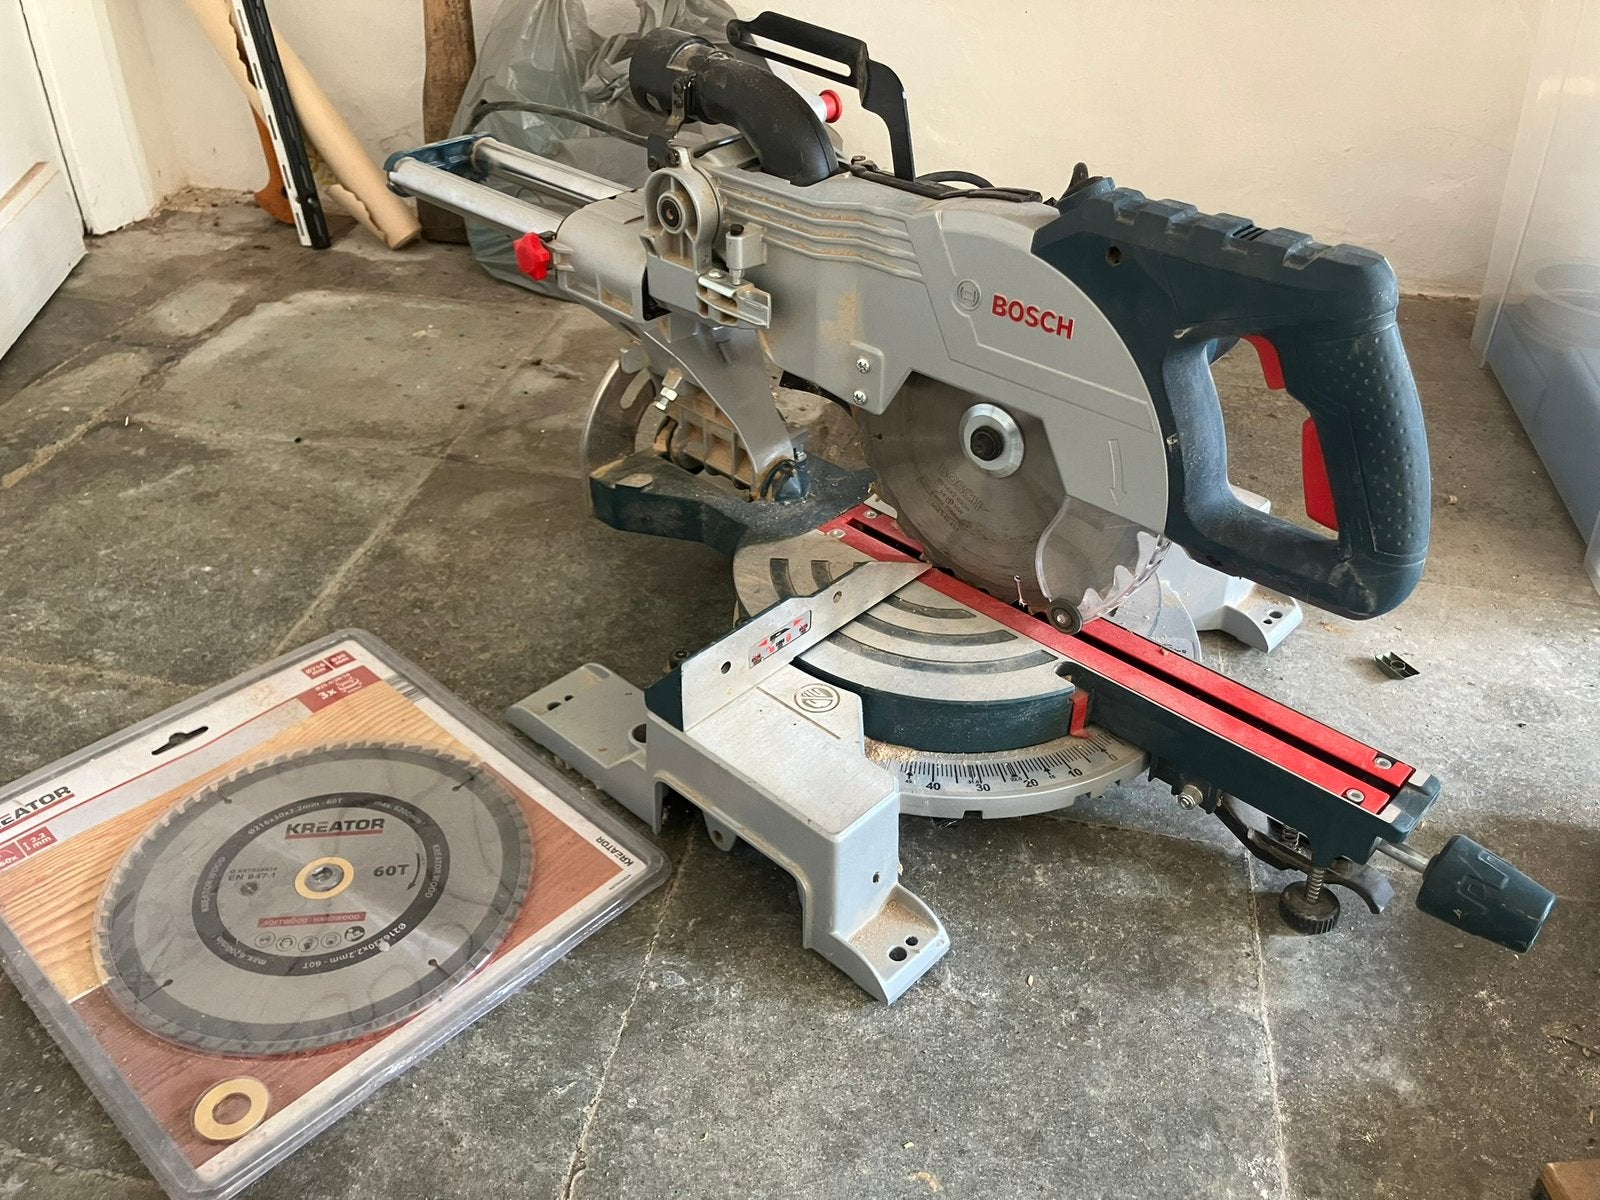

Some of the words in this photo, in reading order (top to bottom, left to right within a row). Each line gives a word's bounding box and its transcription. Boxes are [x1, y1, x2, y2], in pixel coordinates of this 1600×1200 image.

[992, 294, 1075, 340] BOSCH
[318, 689, 337, 700] 3x
[1068, 768, 1083, 778] 10
[925, 782, 941, 791] 40
[976, 783, 991, 792] 30
[1024, 779, 1039, 788] 20
[0, 786, 71, 828] EATOR
[326, 797, 343, 805] 60T
[285, 818, 385, 835] KREATOR
[30, 832, 47, 843] 2.2
[33, 836, 52, 849] mm
[596, 836, 634, 867] KREATOR
[432, 844, 443, 874] KREATOR
[373, 864, 409, 877] 60T
[425, 875, 441, 898] WOOD
[302, 960, 321, 969] 60T
